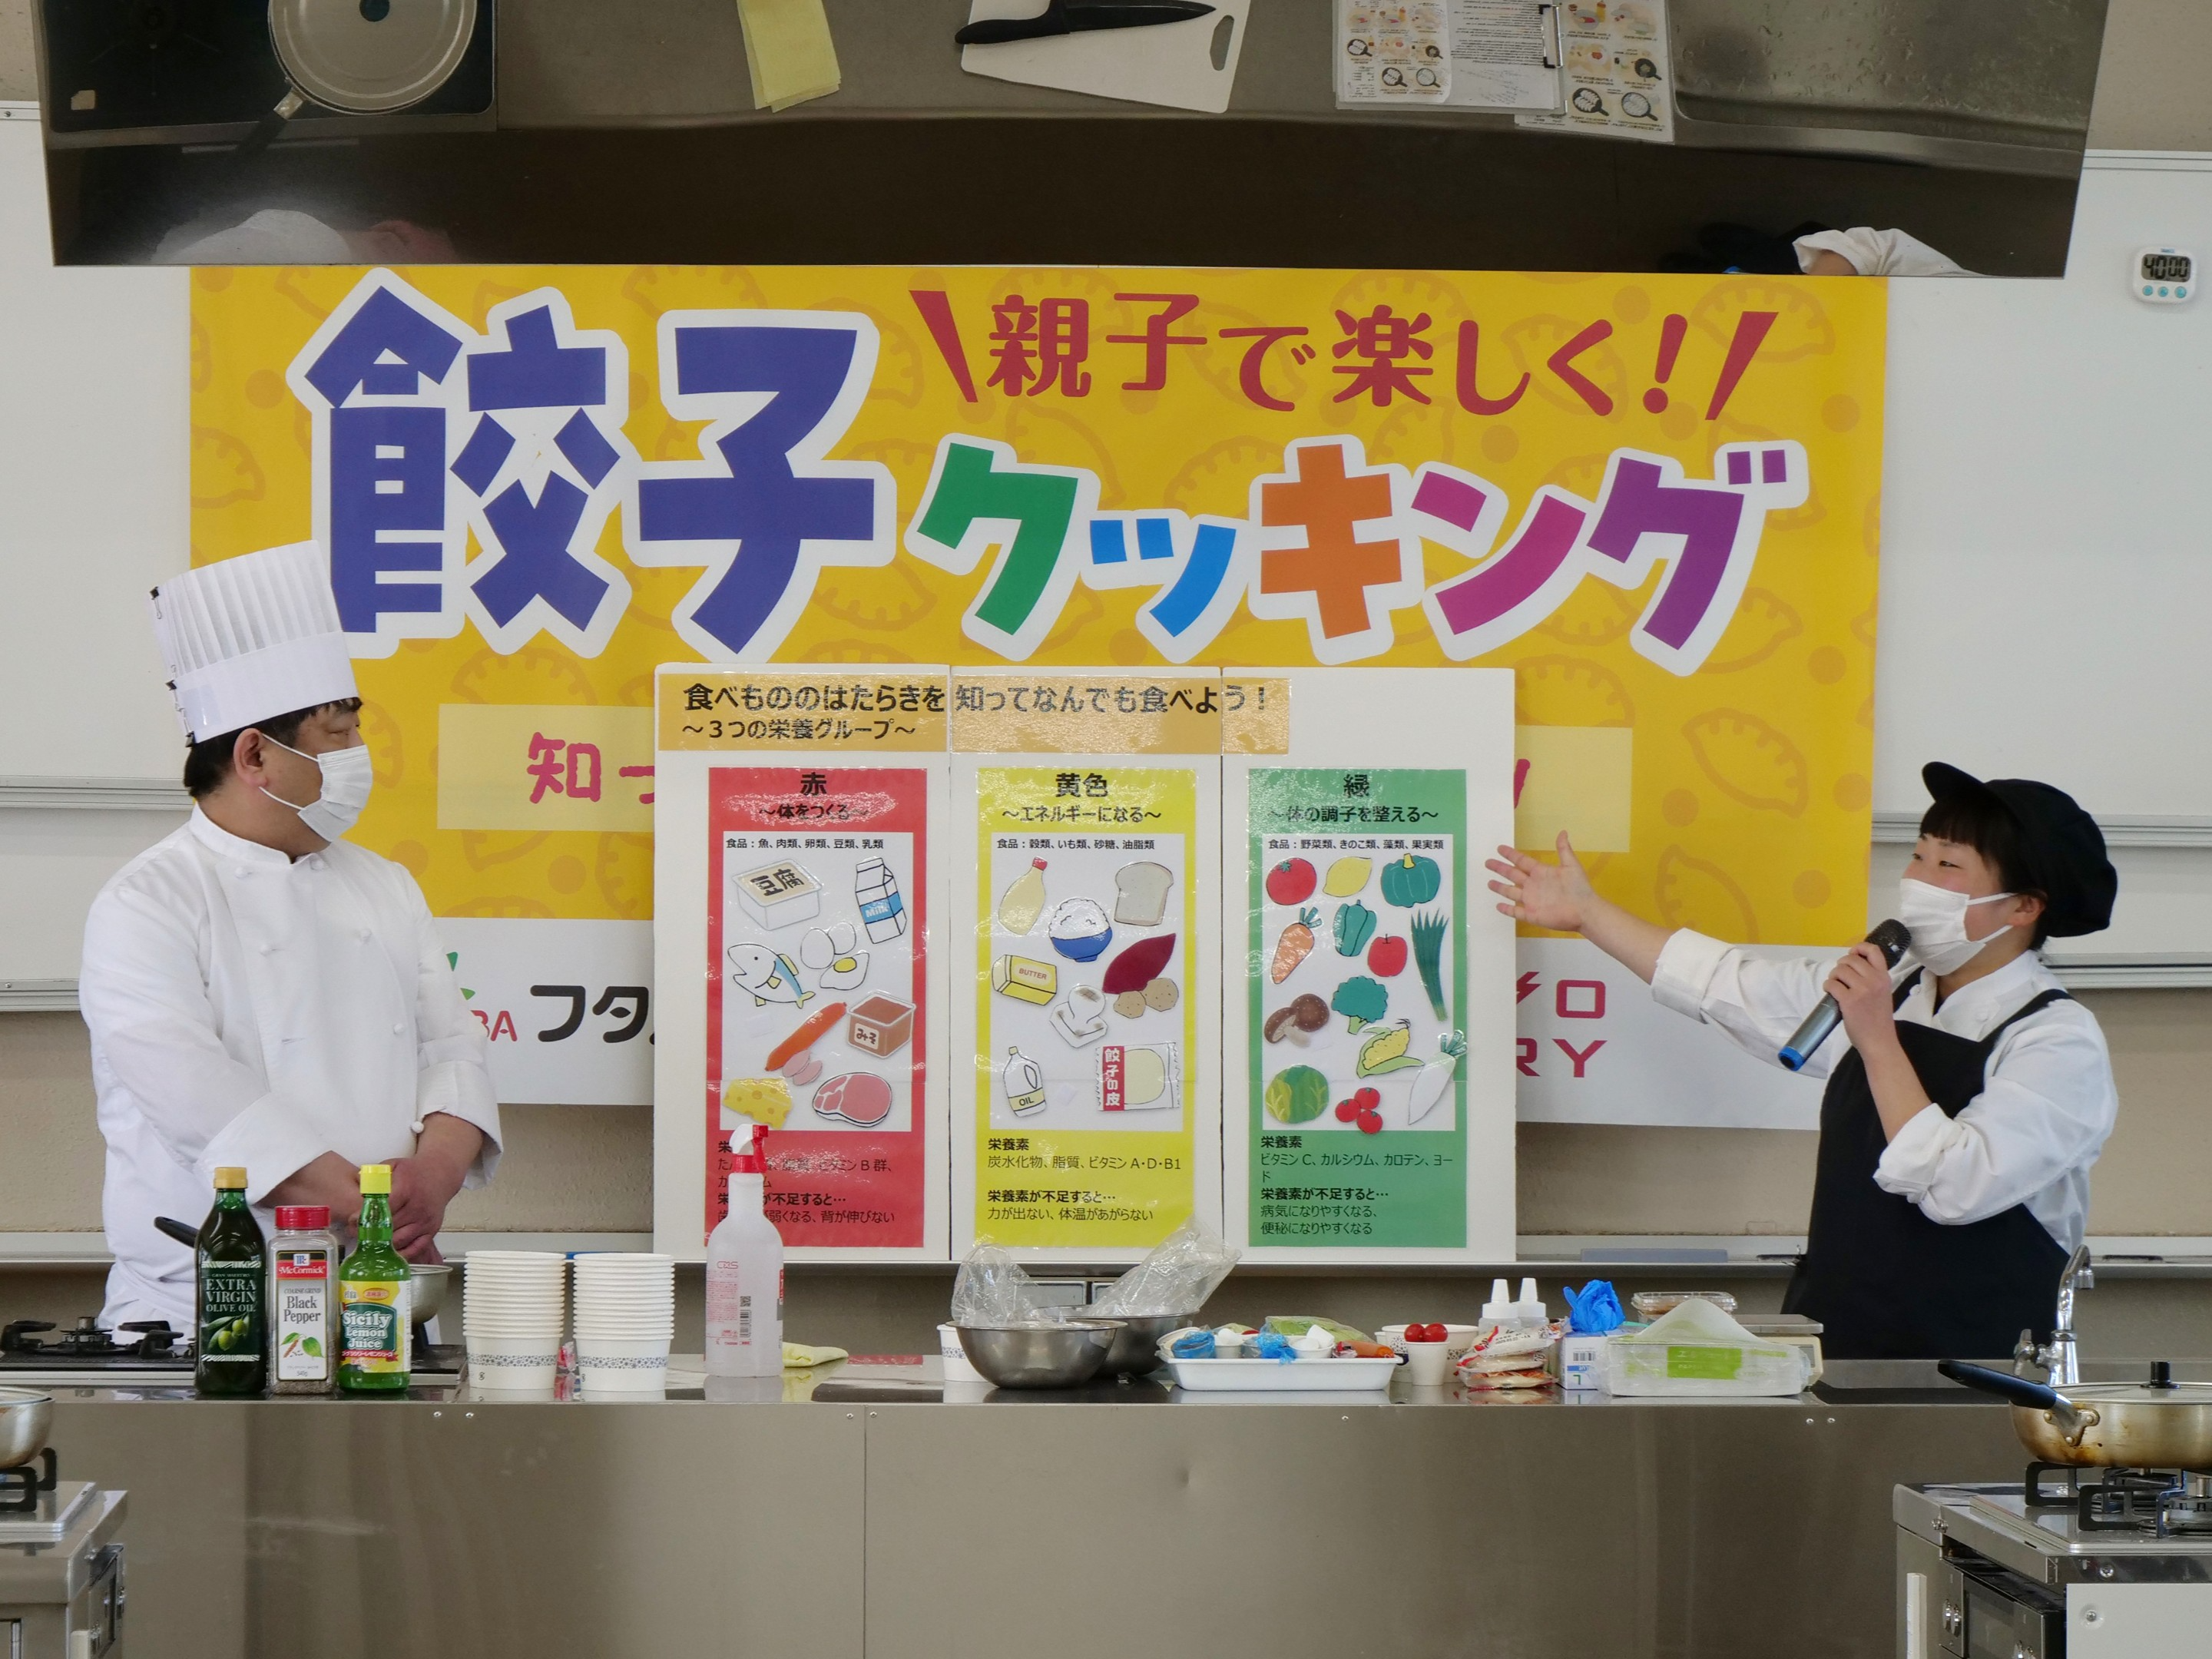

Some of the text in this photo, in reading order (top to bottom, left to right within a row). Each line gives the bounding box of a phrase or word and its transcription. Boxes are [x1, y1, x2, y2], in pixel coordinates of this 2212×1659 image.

[800, 772, 827, 796] 赤
[1055, 773, 1108, 797] 黄色
[1343, 774, 1370, 799] 緑
[750, 868, 805, 897] 豆腐
[1018, 968, 1047, 981] BUTTER
[530, 985, 654, 1045] フタ
[856, 1028, 878, 1045] みそ
[1104, 1048, 1121, 1107] 餃子の皮
[1019, 1097, 1035, 1106] OIL
[988, 1138, 1029, 1151] 栄養素
[1260, 1136, 1302, 1149] 栄養素
[1261, 1171, 1270, 1183] ド
[988, 1207, 1154, 1221] 力が出ない、体温があがらない
[1260, 1205, 1377, 1218] 病気になりやすくなる、
[1260, 1223, 1373, 1235] 便秘になりやすくなる
[279, 1266, 326, 1275] McCormick
[206, 1279, 257, 1290] EXTRA
[206, 1291, 257, 1303] VIRGIN
[286, 1296, 317, 1309] Black
[283, 1310, 321, 1324] Pepper
[343, 1311, 392, 1327] Sicily
[346, 1327, 386, 1338] Lemon
[348, 1338, 382, 1349] Juice
